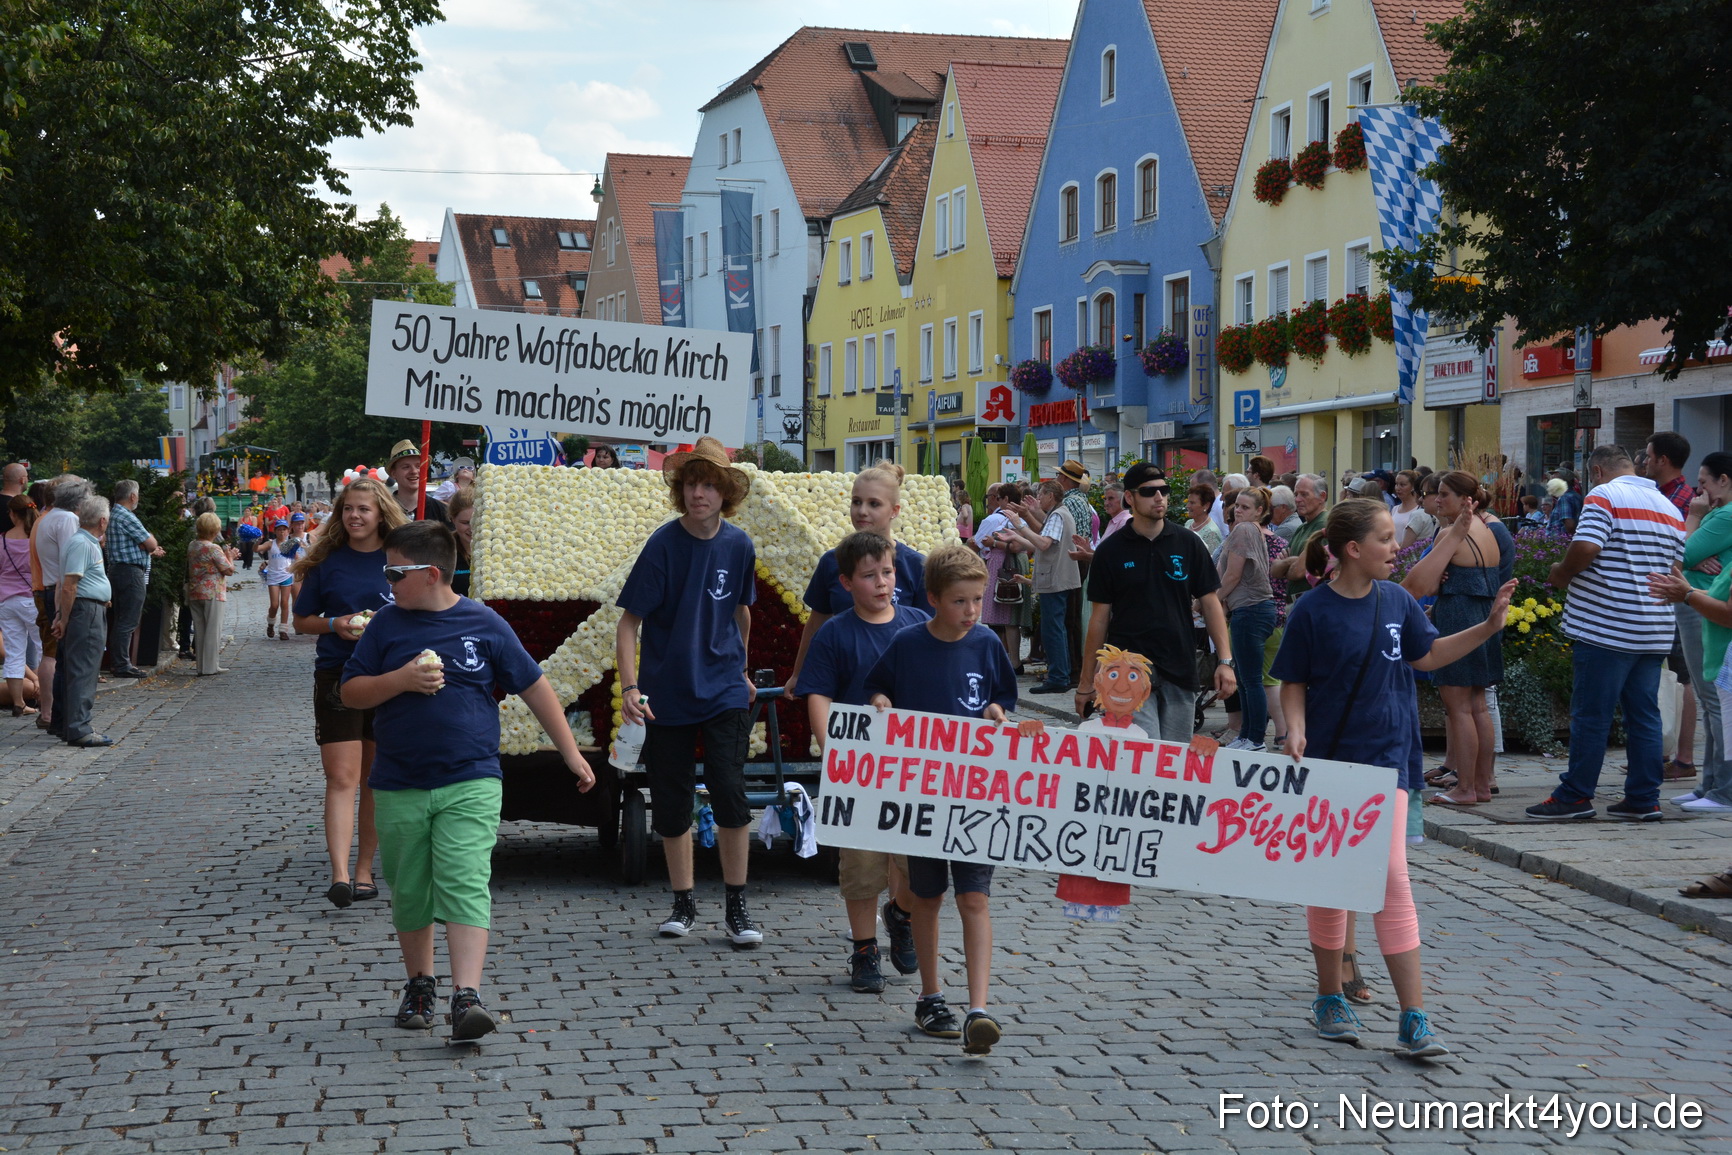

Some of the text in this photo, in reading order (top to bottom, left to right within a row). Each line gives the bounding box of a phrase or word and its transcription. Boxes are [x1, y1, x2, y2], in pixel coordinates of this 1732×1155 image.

[660, 269, 683, 322] K&L
[727, 254, 749, 310] K&L
[851, 307, 874, 330] HOTEL
[392, 313, 729, 381] 50 Jahre Woffabecka Kirch
[1458, 360, 1473, 375] KINO
[495, 383, 612, 426] machen's
[619, 393, 711, 438] möglich
[848, 417, 881, 433] Restaurant
[1240, 395, 1255, 423] P
[497, 441, 545, 460] STAUF
[828, 711, 1310, 795] WIR MINISTRANTEN VON
[827, 748, 1061, 809] WOFFENBACH
[1074, 782, 1206, 826] BRINGEN
[821, 795, 1163, 878] IN DIE KIRCHE
